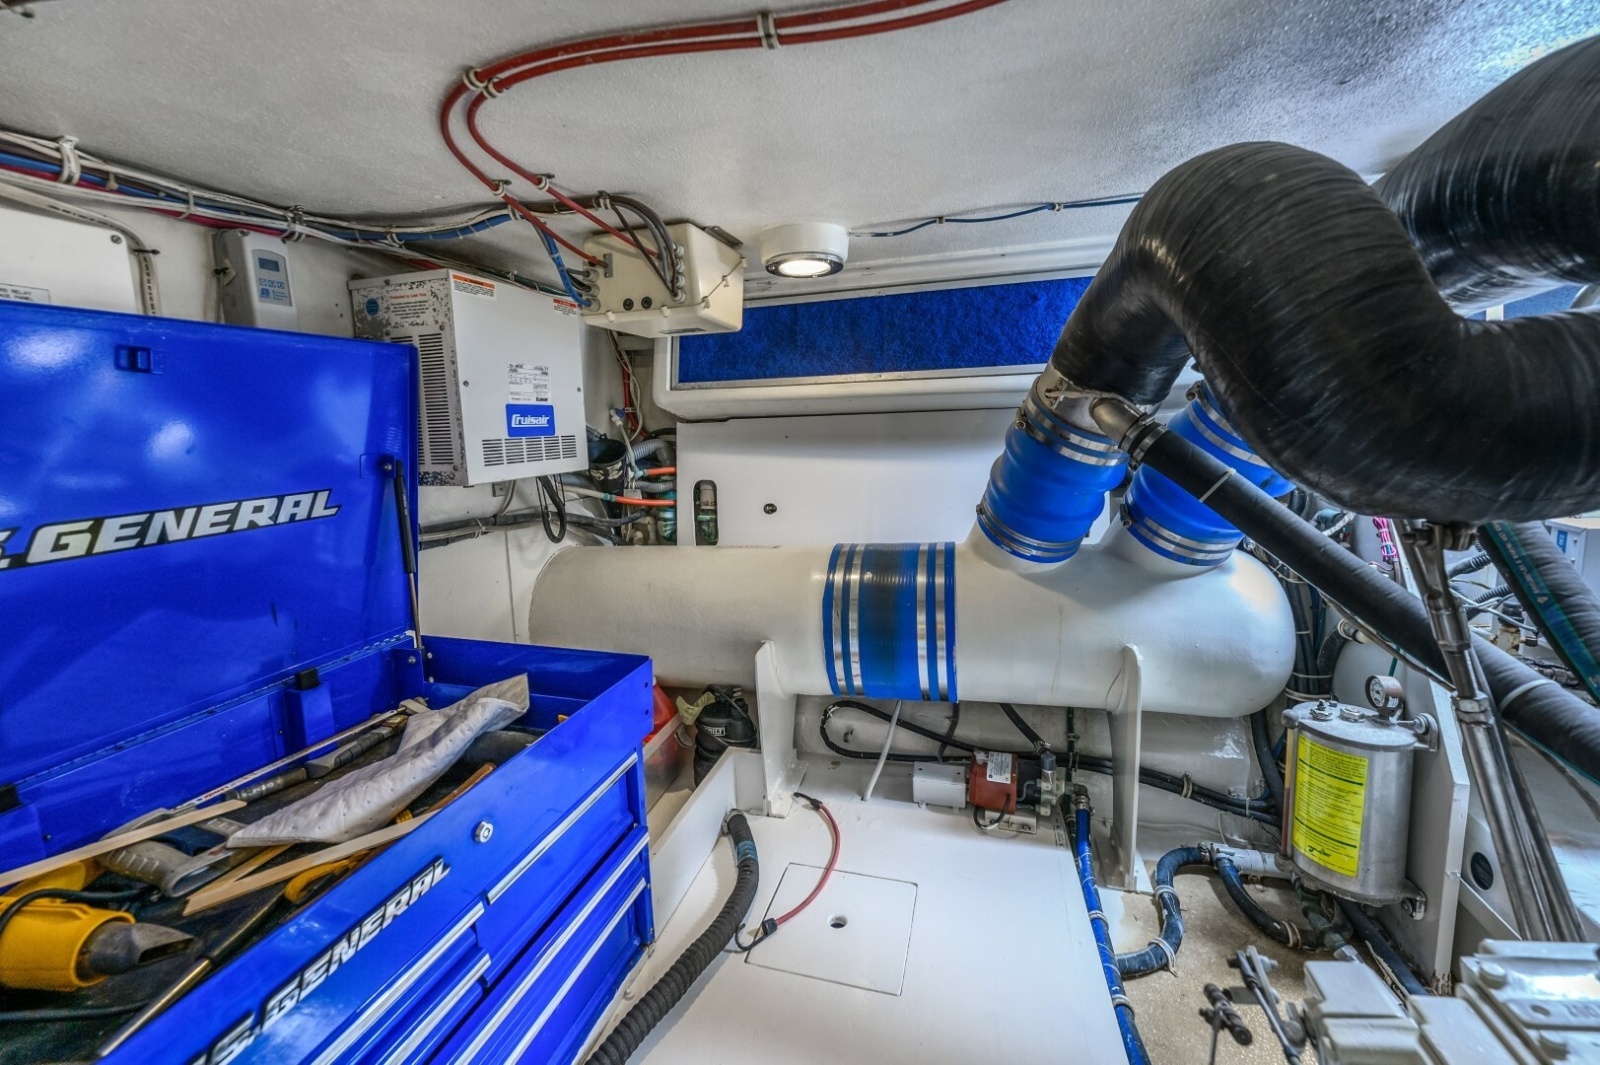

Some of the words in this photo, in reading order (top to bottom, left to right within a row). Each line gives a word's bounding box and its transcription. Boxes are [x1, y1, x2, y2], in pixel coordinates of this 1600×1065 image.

[511, 414, 550, 427] Cruisair
[26, 490, 339, 564] GENERAL
[262, 858, 450, 1032] GENERAL
